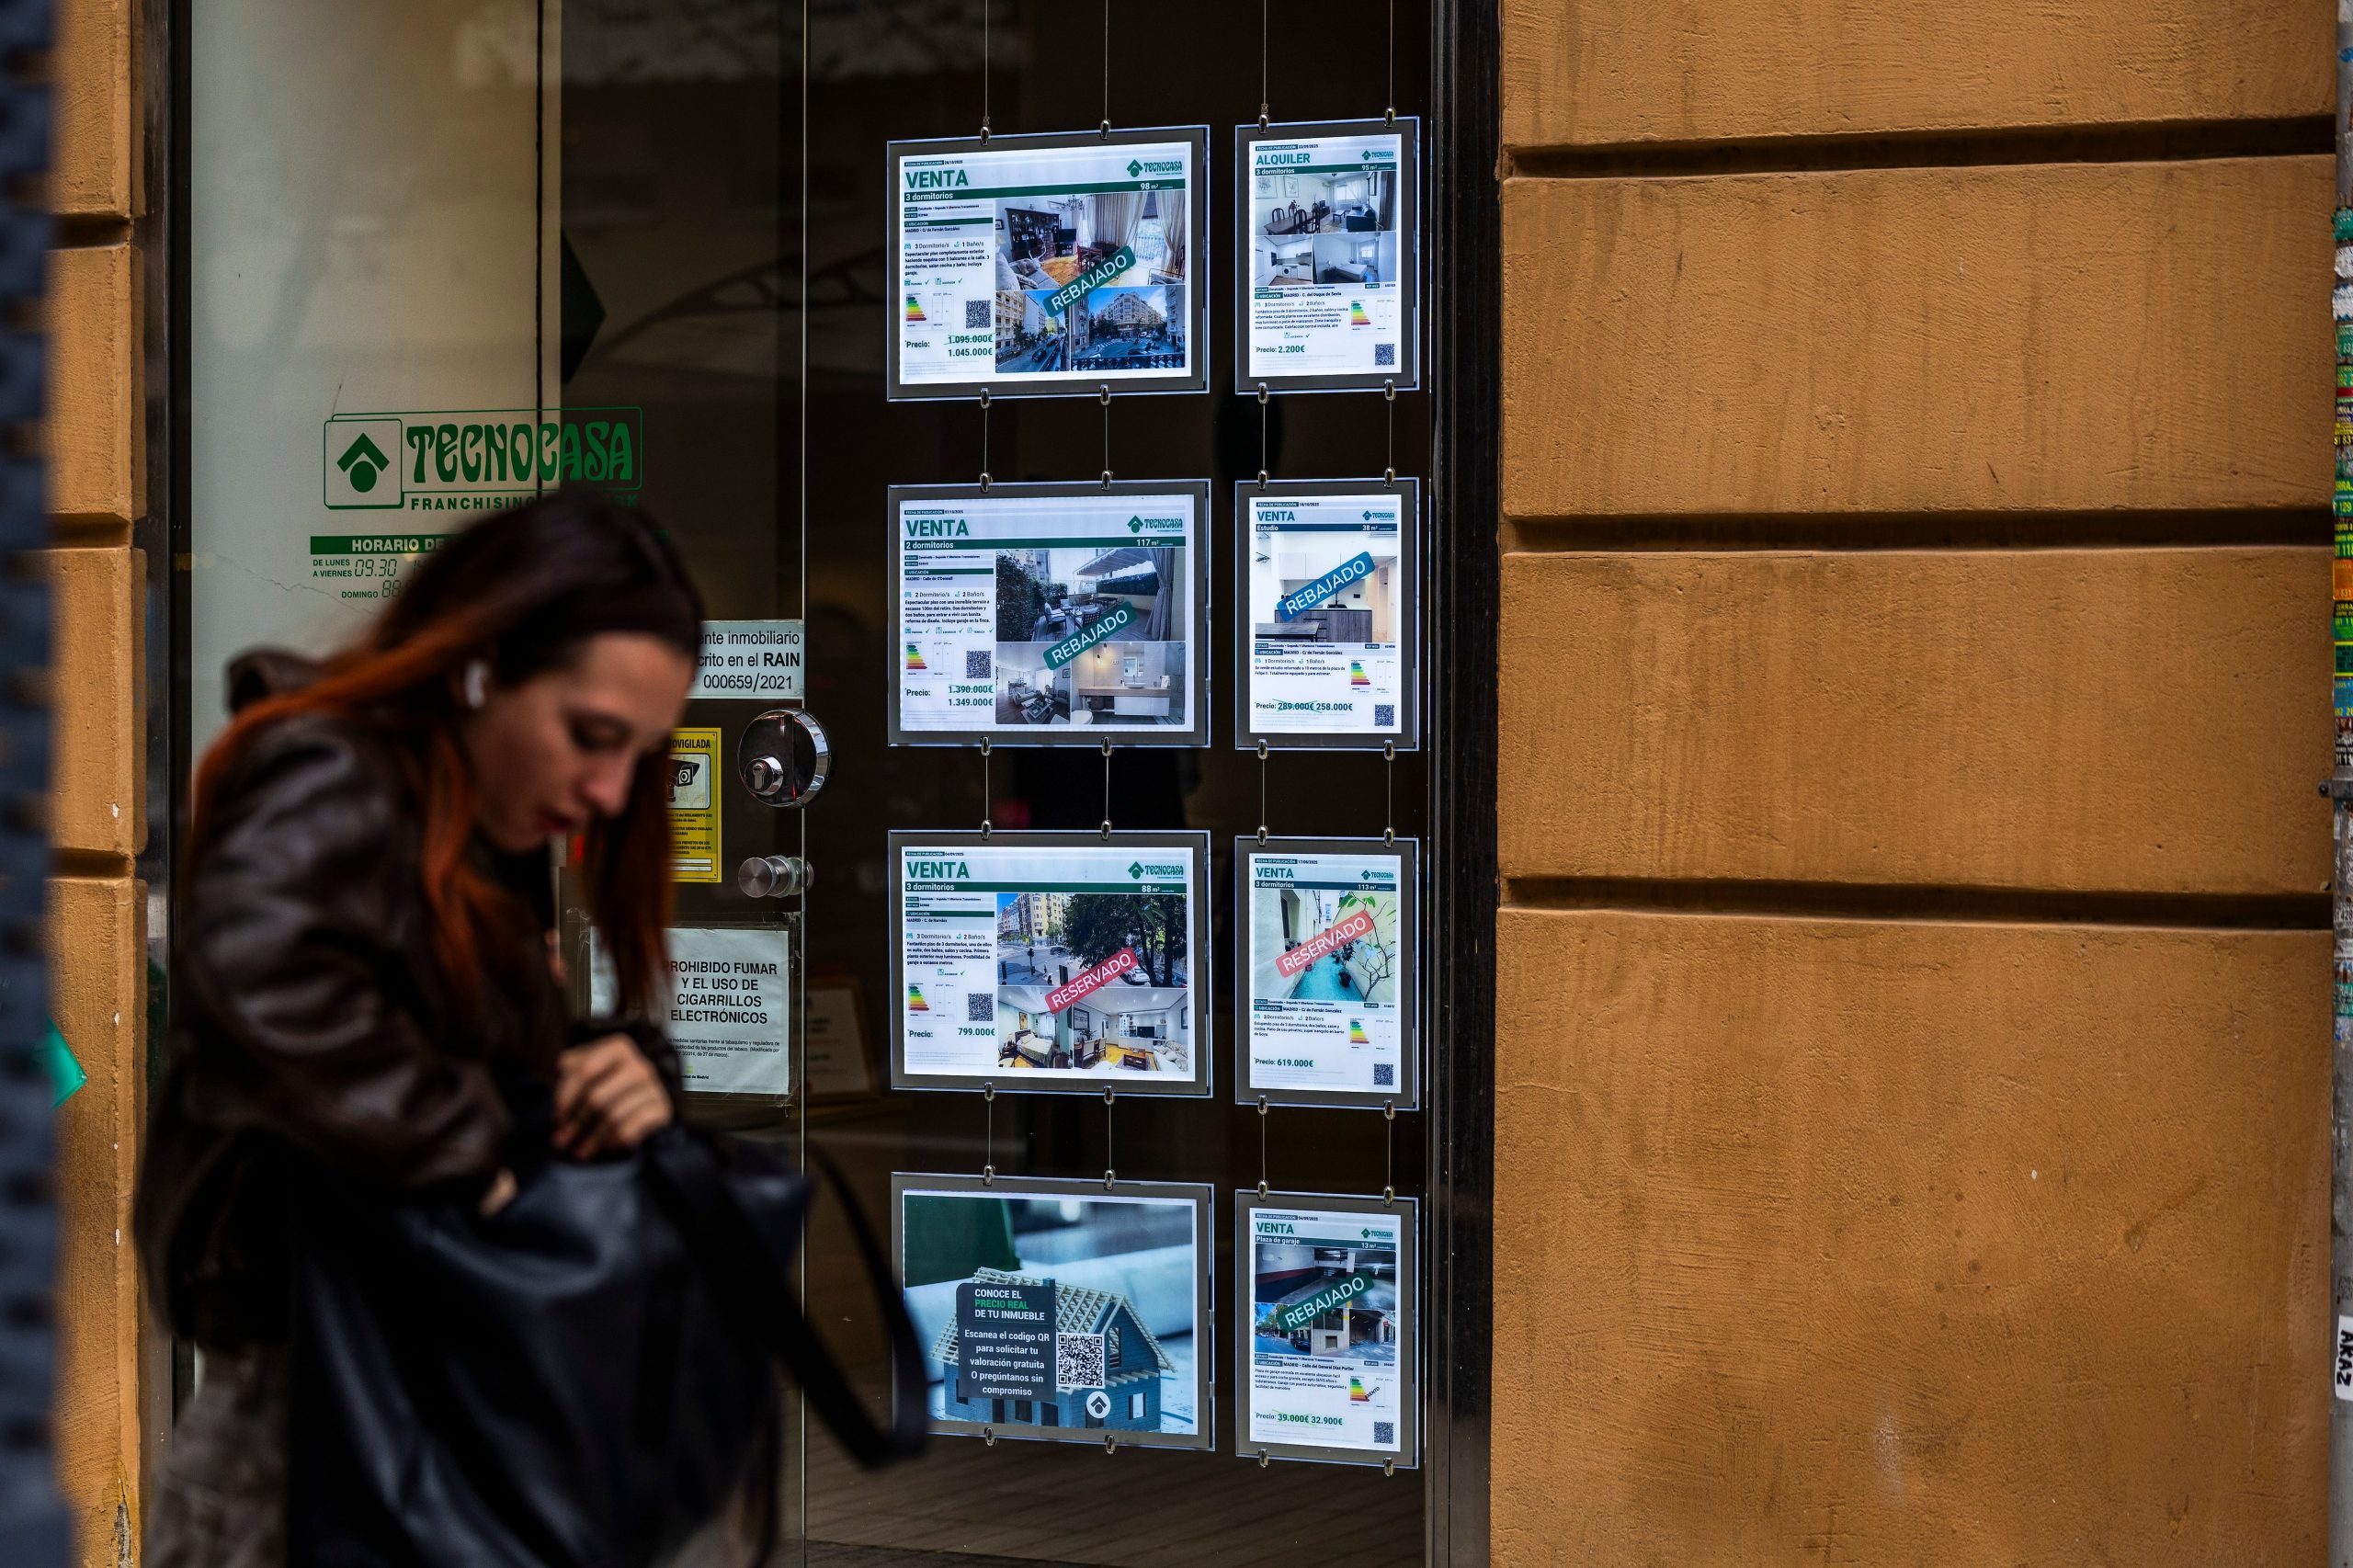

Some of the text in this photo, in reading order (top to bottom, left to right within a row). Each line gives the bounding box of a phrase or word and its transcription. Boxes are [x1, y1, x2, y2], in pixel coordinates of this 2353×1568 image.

[1256, 153, 1310, 165] ALQUILER
[1144, 161, 1182, 172] TECNOCASA
[905, 169, 968, 188] VENTA
[912, 192, 953, 200] dormitorios
[1050, 253, 1127, 311] REBAJADO
[948, 335, 992, 344] 1.095.000€
[407, 421, 633, 484] TECNOCASA
[1257, 511, 1295, 521] VENTA
[906, 519, 969, 536] VENTA
[1144, 518, 1183, 529] TECNOCASA
[352, 538, 444, 551] HORARIO DE
[355, 559, 397, 577] 09.30
[1286, 560, 1365, 614] REBAJADO
[699, 631, 800, 645] ente inmobiliario
[1051, 609, 1128, 664] REBAJADO
[698, 652, 800, 667] crito en el RAIN
[704, 673, 792, 692] 000659/2021
[948, 685, 993, 693] 1.390.000€
[672, 739, 711, 748] OVIGILADA
[907, 862, 969, 878] VENTA
[1145, 865, 1183, 875] TECNOCASA
[1256, 868, 1294, 878] VENTA
[1282, 917, 1366, 971] RESERVADO
[670, 961, 777, 975] ROHIBIDO FUMAR
[681, 978, 758, 990] Y EL USO DE
[1051, 953, 1131, 1008] RESERVADO
[677, 994, 762, 1007] CIGARRILLOS
[671, 1009, 768, 1024] ELECTRÓNICOS
[1277, 1059, 1313, 1067] 619.000€
[1256, 1223, 1294, 1234] VENTA
[975, 1289, 1009, 1298] CONOCE
[975, 1299, 1029, 1309] PRECIO REAL
[1285, 1277, 1365, 1327] REBAJADO
[988, 1310, 999, 1318] TU
[1001, 1311, 1045, 1321] INMUEBLE
[965, 1330, 1050, 1342] Escanea el codigo QR
[996, 1344, 1028, 1354] solicitar
[1030, 1346, 1038, 1355] tu
[970, 1357, 1045, 1369] valoración gratuita
[979, 1371, 1029, 1382] pregúntanos
[982, 1386, 1032, 1396] compromiso
[1365, 1387, 1380, 1398] EXENTO
[1278, 1414, 1309, 1423] 39.000€
[1311, 1416, 1343, 1425] 32.900€
